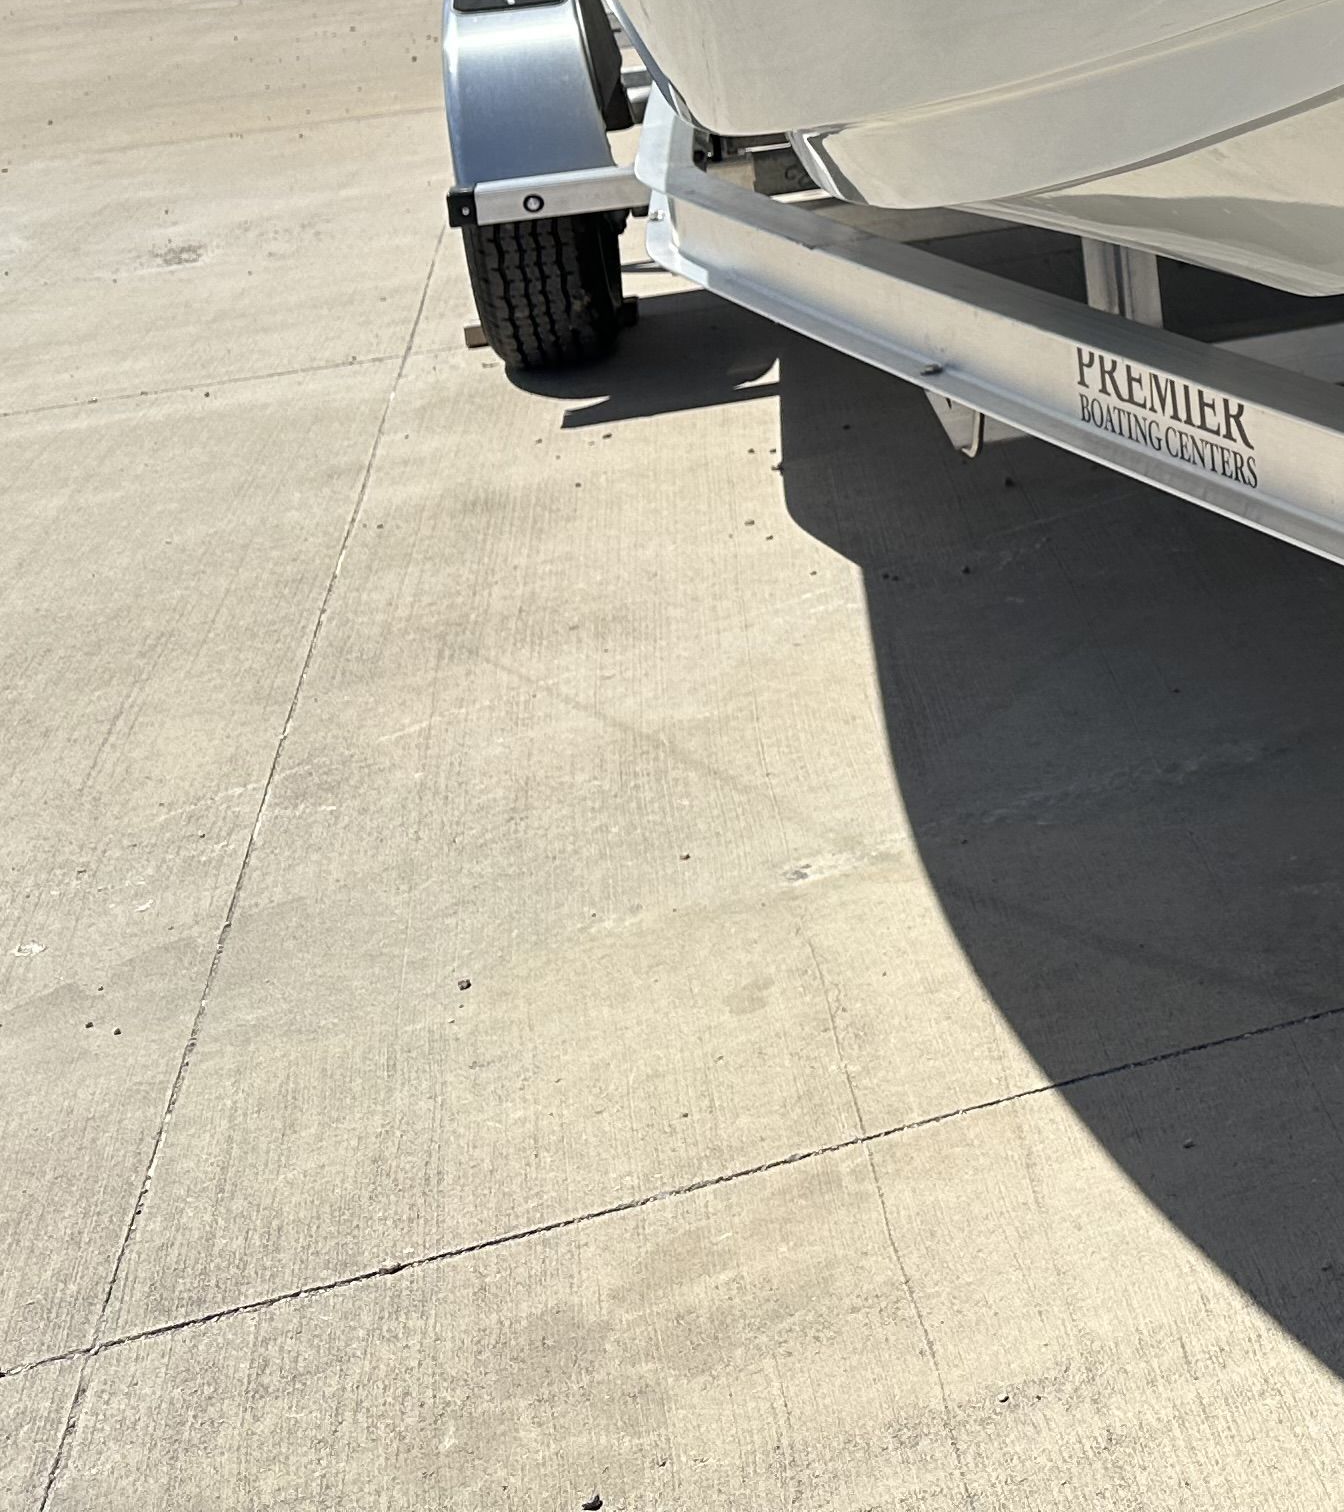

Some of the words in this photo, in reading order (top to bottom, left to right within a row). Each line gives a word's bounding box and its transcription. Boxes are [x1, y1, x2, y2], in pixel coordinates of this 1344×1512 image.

[1077, 346, 1255, 451] PREMIER
[1079, 392, 1162, 452] BOATING
[1166, 425, 1258, 489] CENTERS
